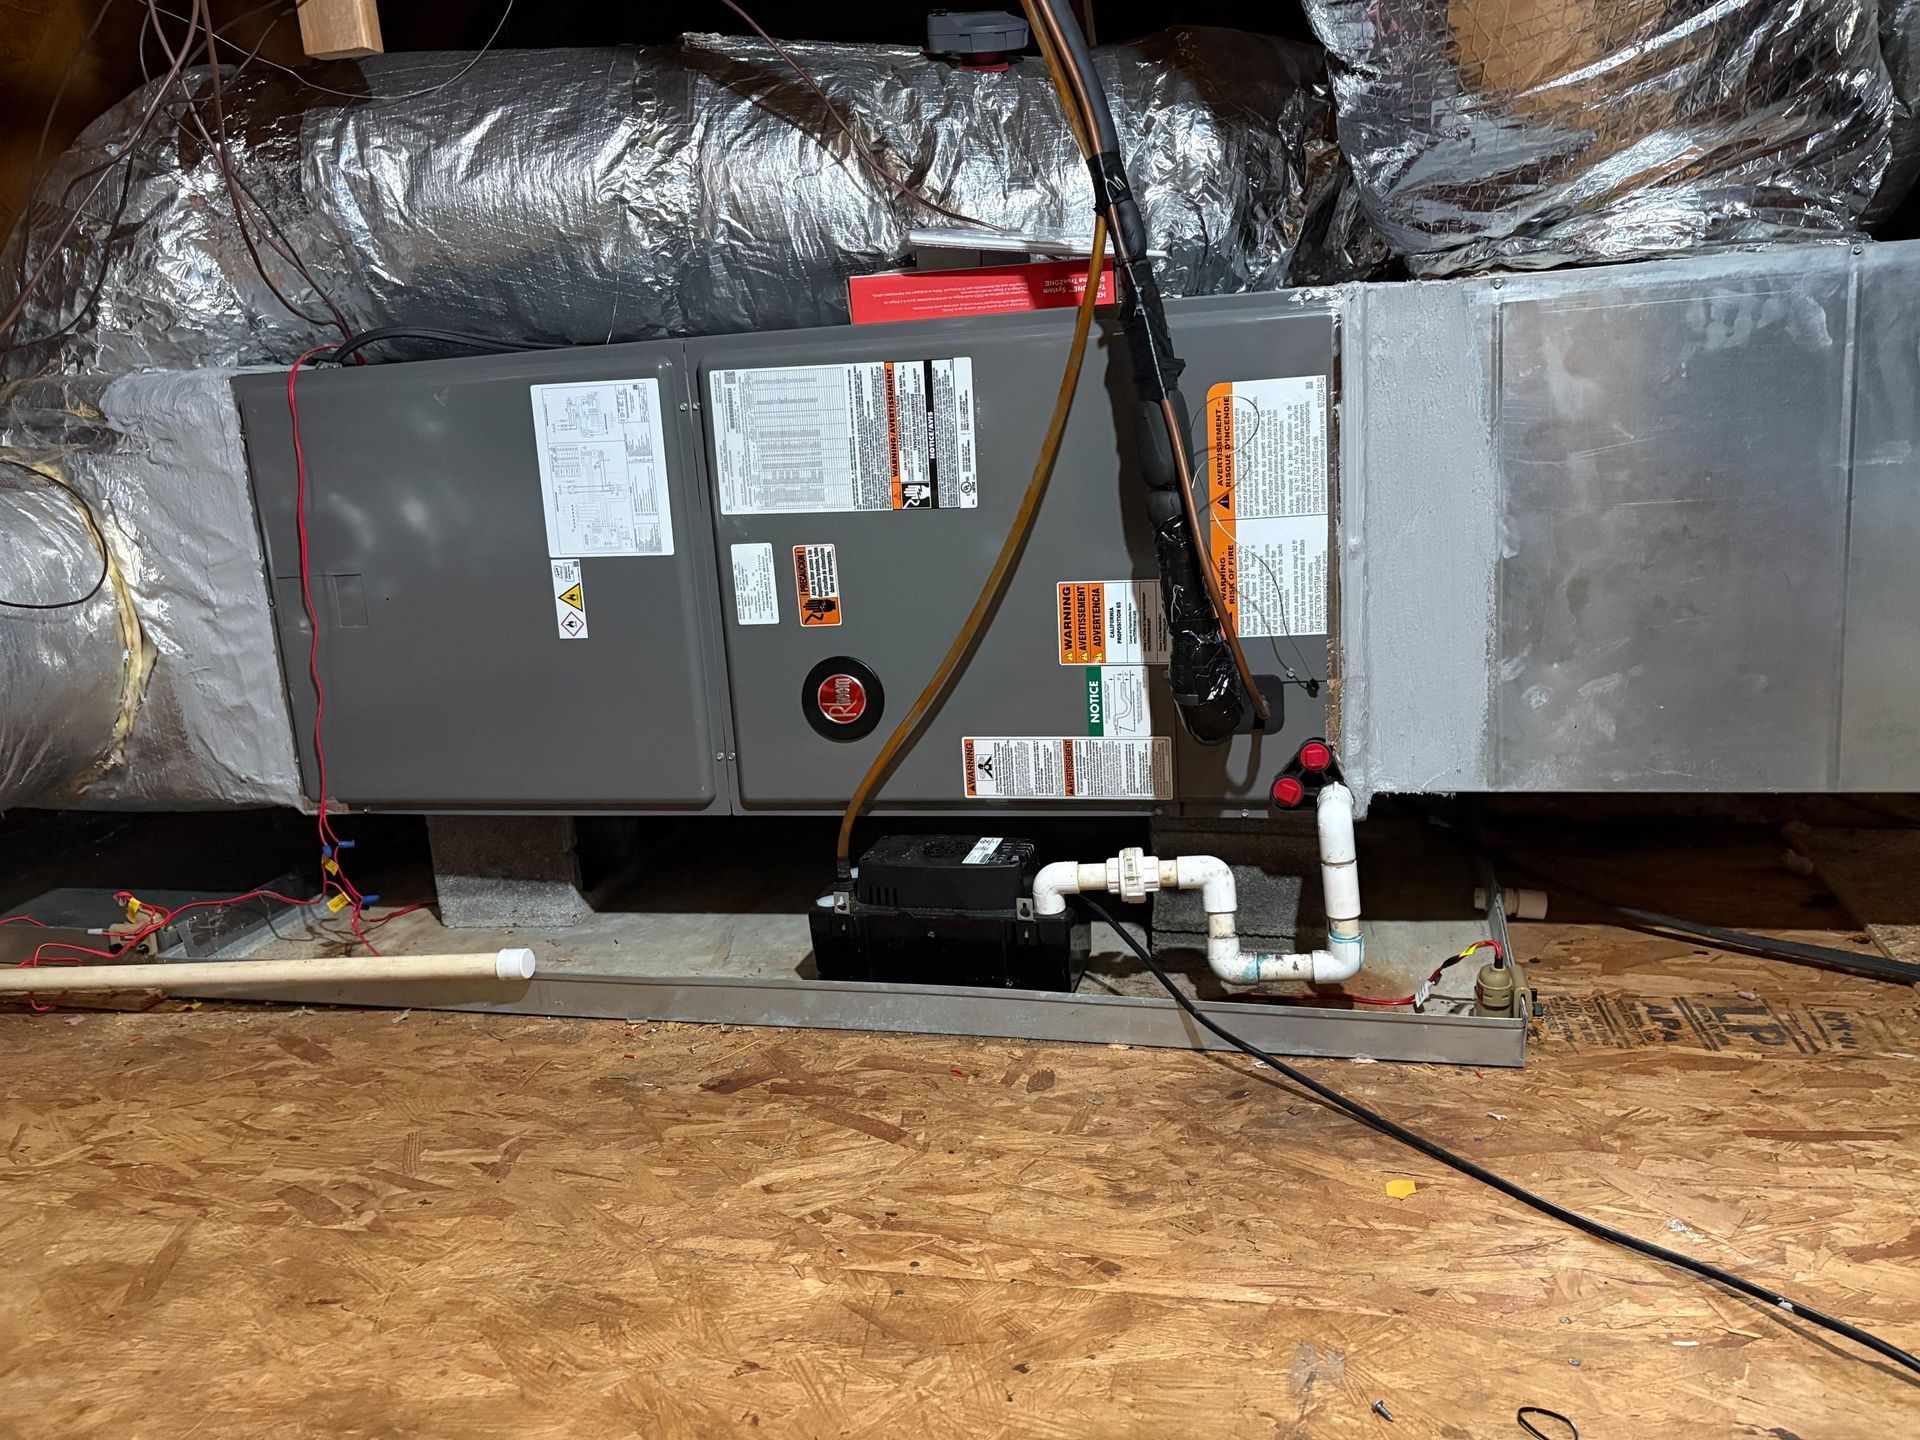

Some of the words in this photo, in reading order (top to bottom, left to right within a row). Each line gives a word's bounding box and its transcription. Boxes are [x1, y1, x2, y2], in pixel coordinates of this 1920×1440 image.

[1042, 286, 1065, 294] System
[886, 368, 898, 476] WARNING/AVERTISSEMENT
[927, 411, 935, 458] NOTICE/AVIS
[1215, 408, 1223, 486] AVERTISSEMENT
[1228, 568, 1234, 579] OF
[1062, 586, 1072, 650] WARNING
[1076, 586, 1086, 650] AVERTISSEMENT
[1092, 588, 1101, 646] ADVERTENCIA
[822, 678, 857, 717] Rheem
[1088, 680, 1099, 722] NOTICE
[965, 742, 974, 784] WARNING
[1064, 740, 1074, 786] AVERTISSEMENT
[1710, 1006, 1793, 1046] LP
